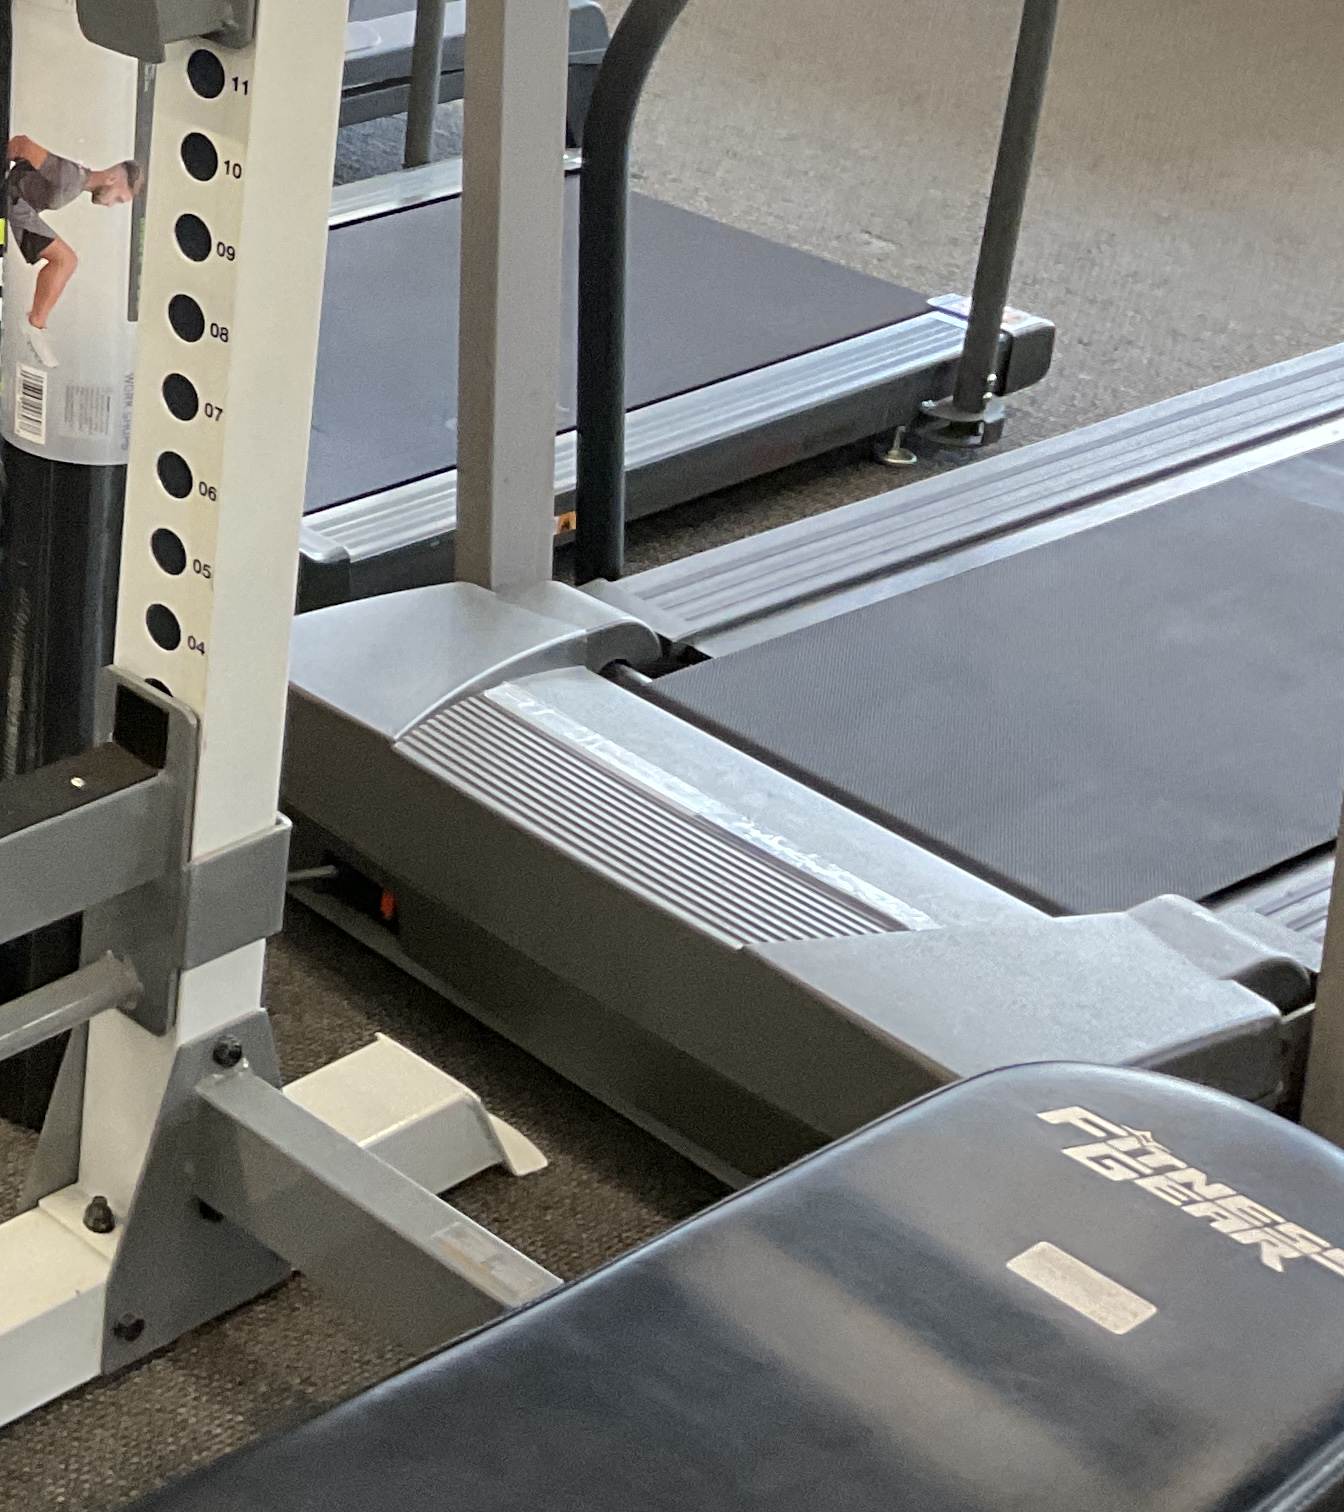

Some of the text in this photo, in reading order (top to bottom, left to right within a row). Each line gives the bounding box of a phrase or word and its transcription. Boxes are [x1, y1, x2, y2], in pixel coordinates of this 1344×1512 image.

[231, 76, 249, 96] 11
[223, 159, 243, 180] 10
[216, 241, 236, 262] 09
[209, 322, 230, 344] 08
[203, 402, 224, 422] 07
[198, 480, 218, 502] 06
[192, 558, 213, 580] 05
[187, 634, 206, 656] 04
[1061, 1140, 1310, 1274] GEAR
